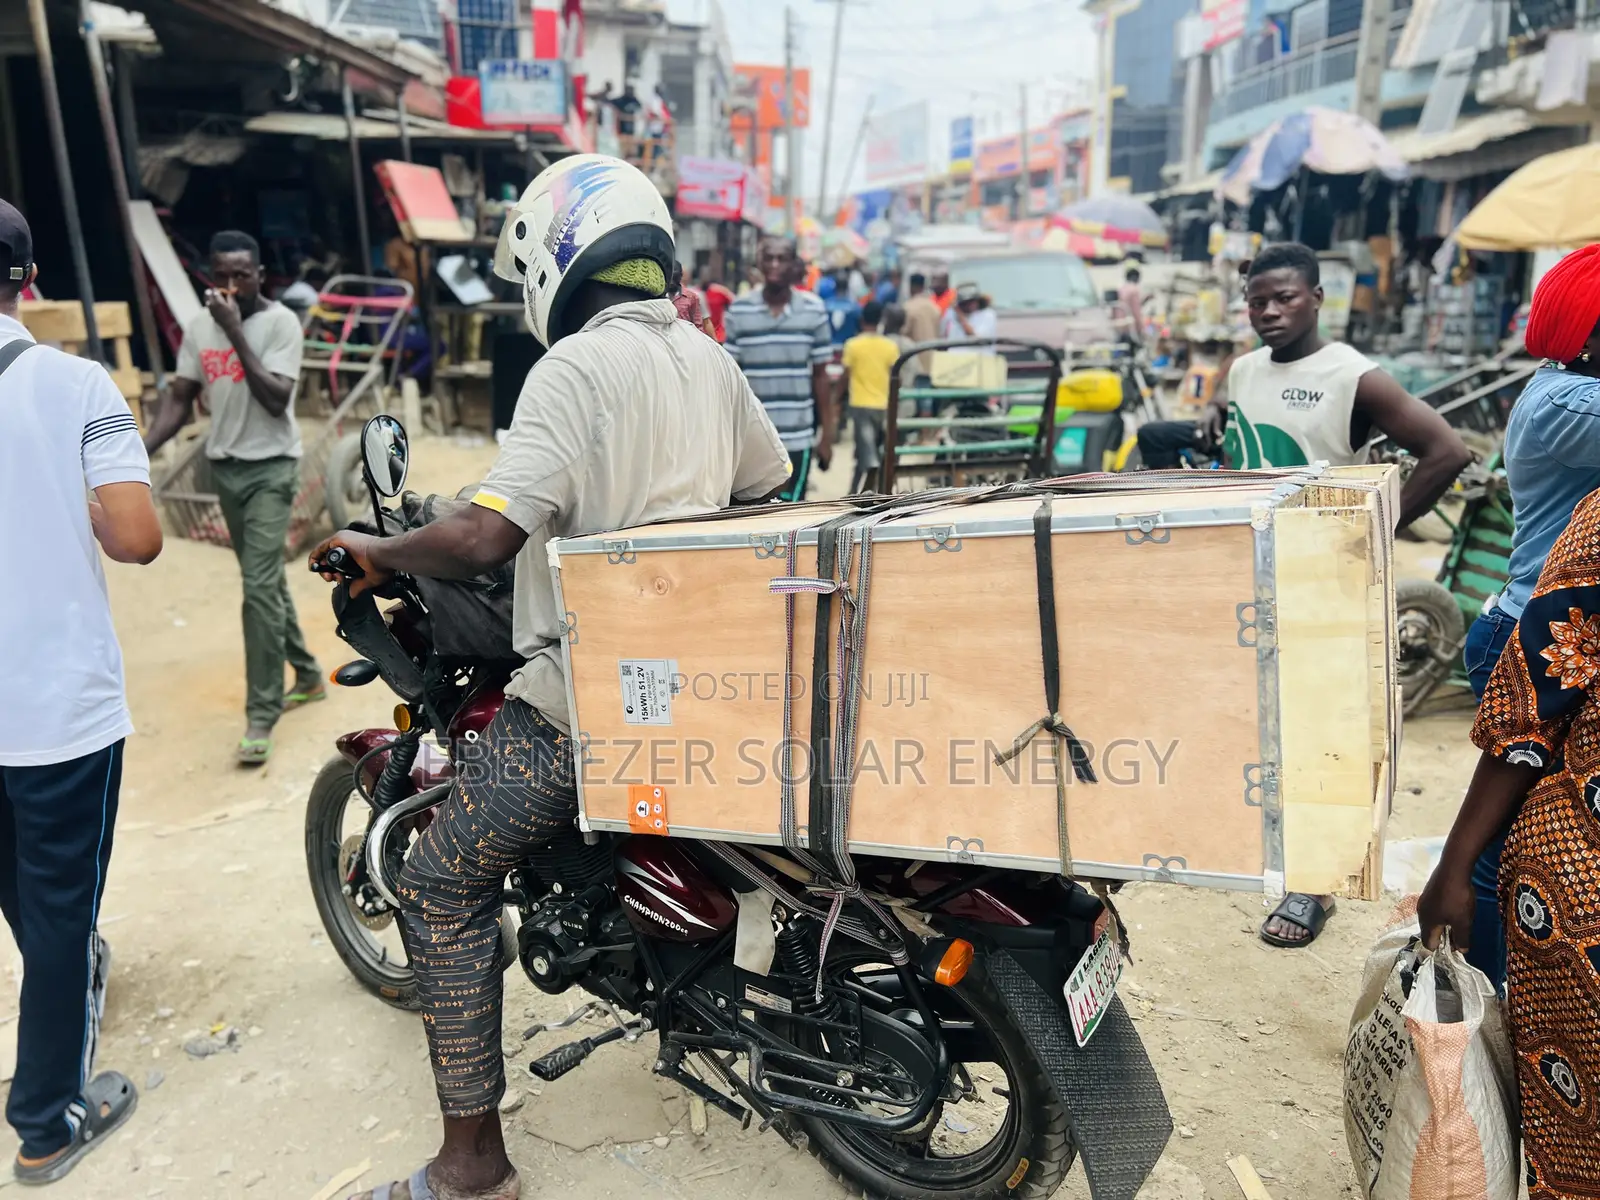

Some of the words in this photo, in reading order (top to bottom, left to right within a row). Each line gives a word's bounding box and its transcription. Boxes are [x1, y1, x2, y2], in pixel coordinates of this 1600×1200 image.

[1281, 388, 1324, 402] GLOW
[637, 666, 646, 690] 51.2V
[640, 693, 649, 721] 15kWh
[562, 920, 584, 930] QLINK
[1082, 930, 1108, 972] LAGOS
[1364, 1101, 1387, 1131] 3345
[1371, 1090, 1393, 1119] 2560
